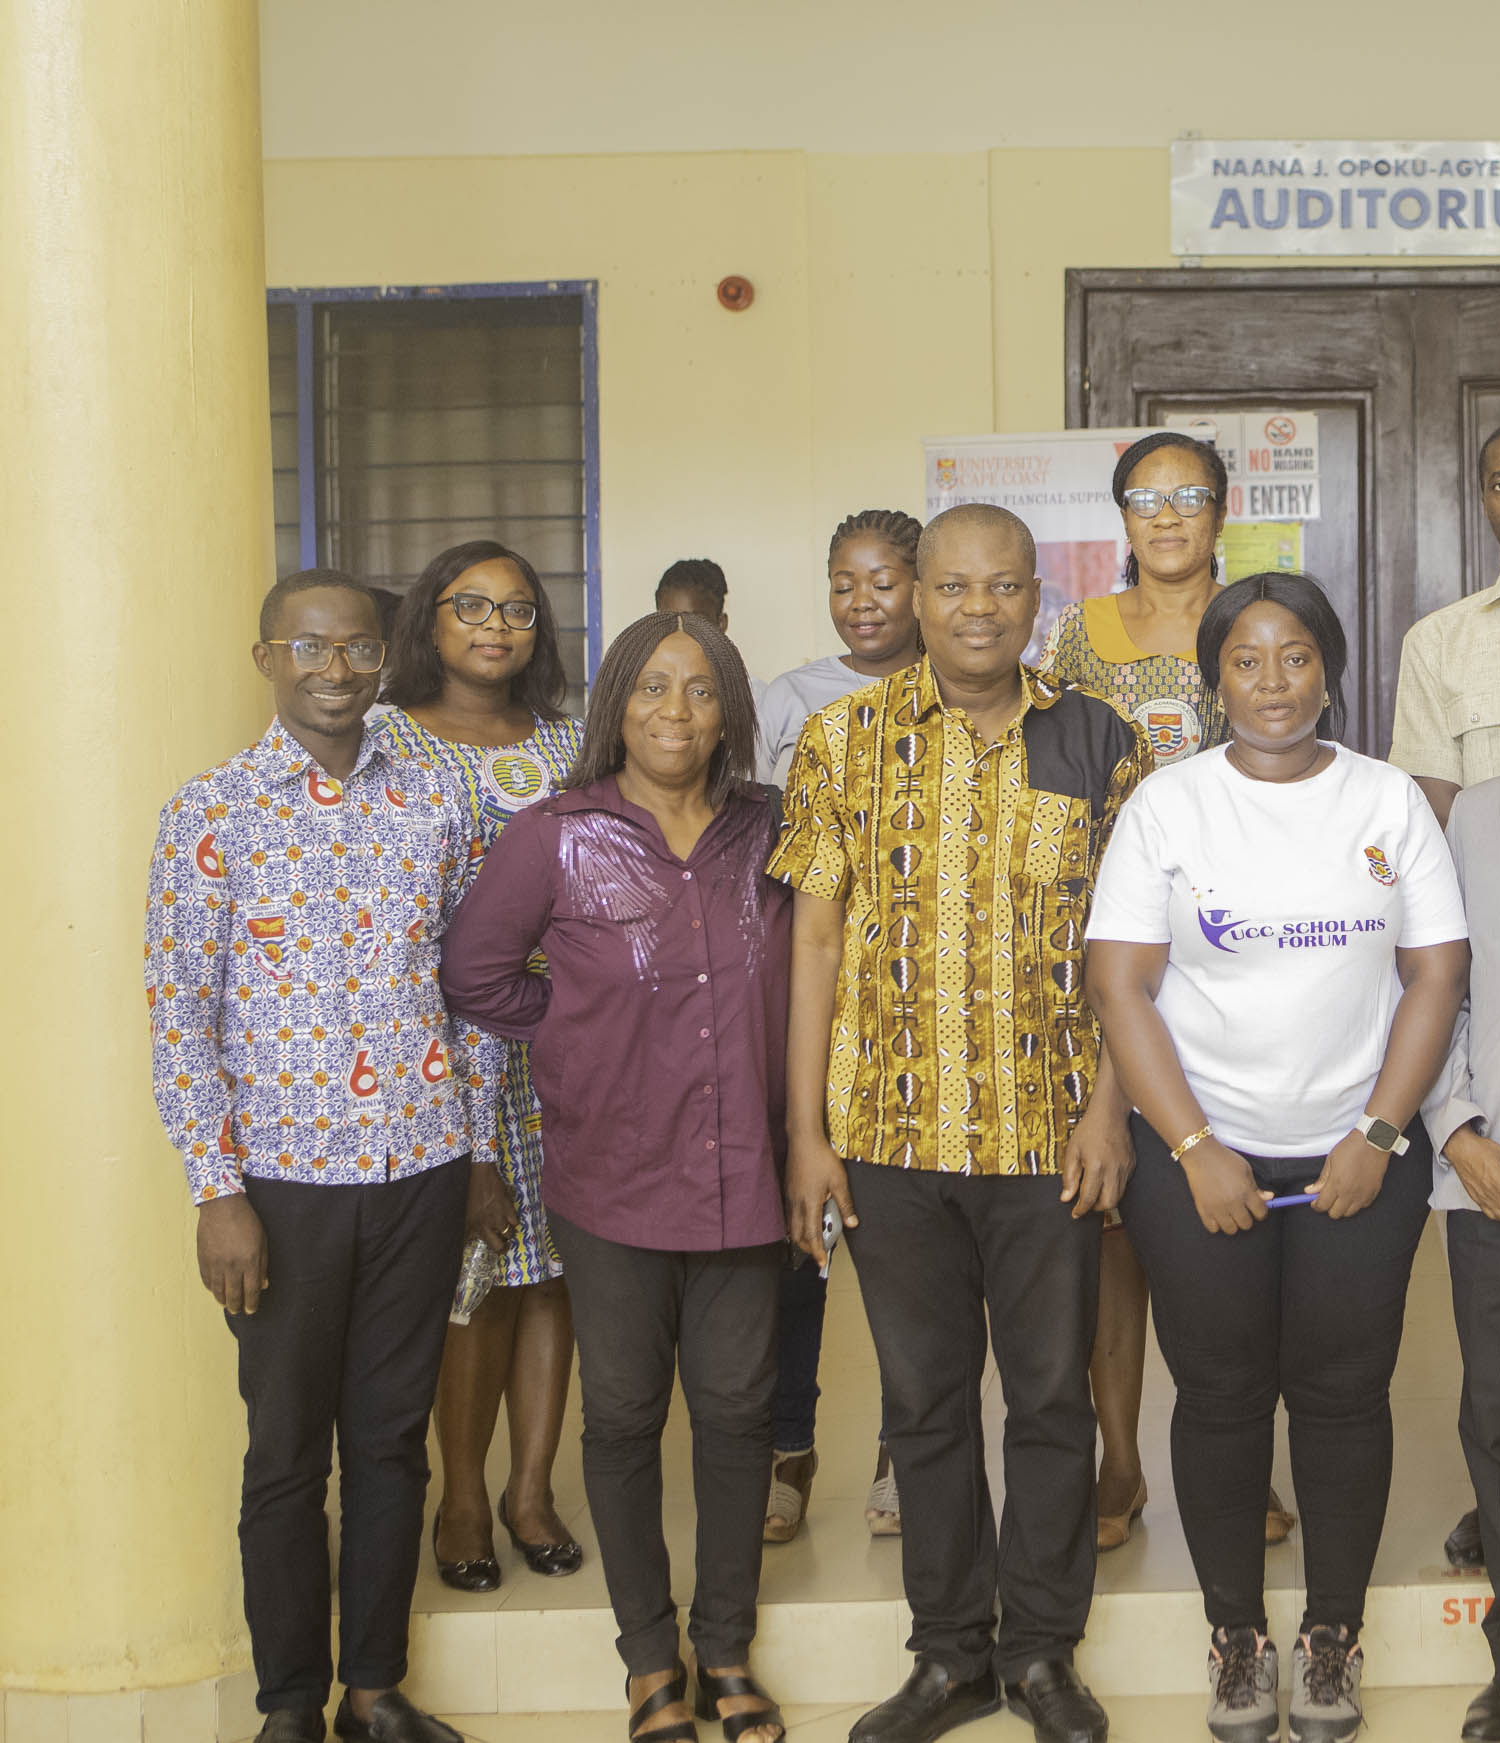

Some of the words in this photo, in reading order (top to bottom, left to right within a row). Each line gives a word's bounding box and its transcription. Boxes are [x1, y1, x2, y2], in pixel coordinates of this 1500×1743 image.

[1211, 159, 1305, 177] NAANA
[1312, 159, 1328, 177] J.
[1248, 447, 1271, 473] NO
[1273, 447, 1314, 459] HAND
[959, 456, 1043, 473] UNIVERSITY
[959, 472, 997, 489] CAPE
[1001, 471, 1049, 487] COAST
[1070, 490, 1113, 505] SUPPO
[1230, 485, 1243, 517] O
[1250, 483, 1314, 516] ENTRY
[1230, 925, 1274, 942] UCC
[1283, 918, 1386, 936] SCHOLARS
[1278, 934, 1348, 949] FORUM
